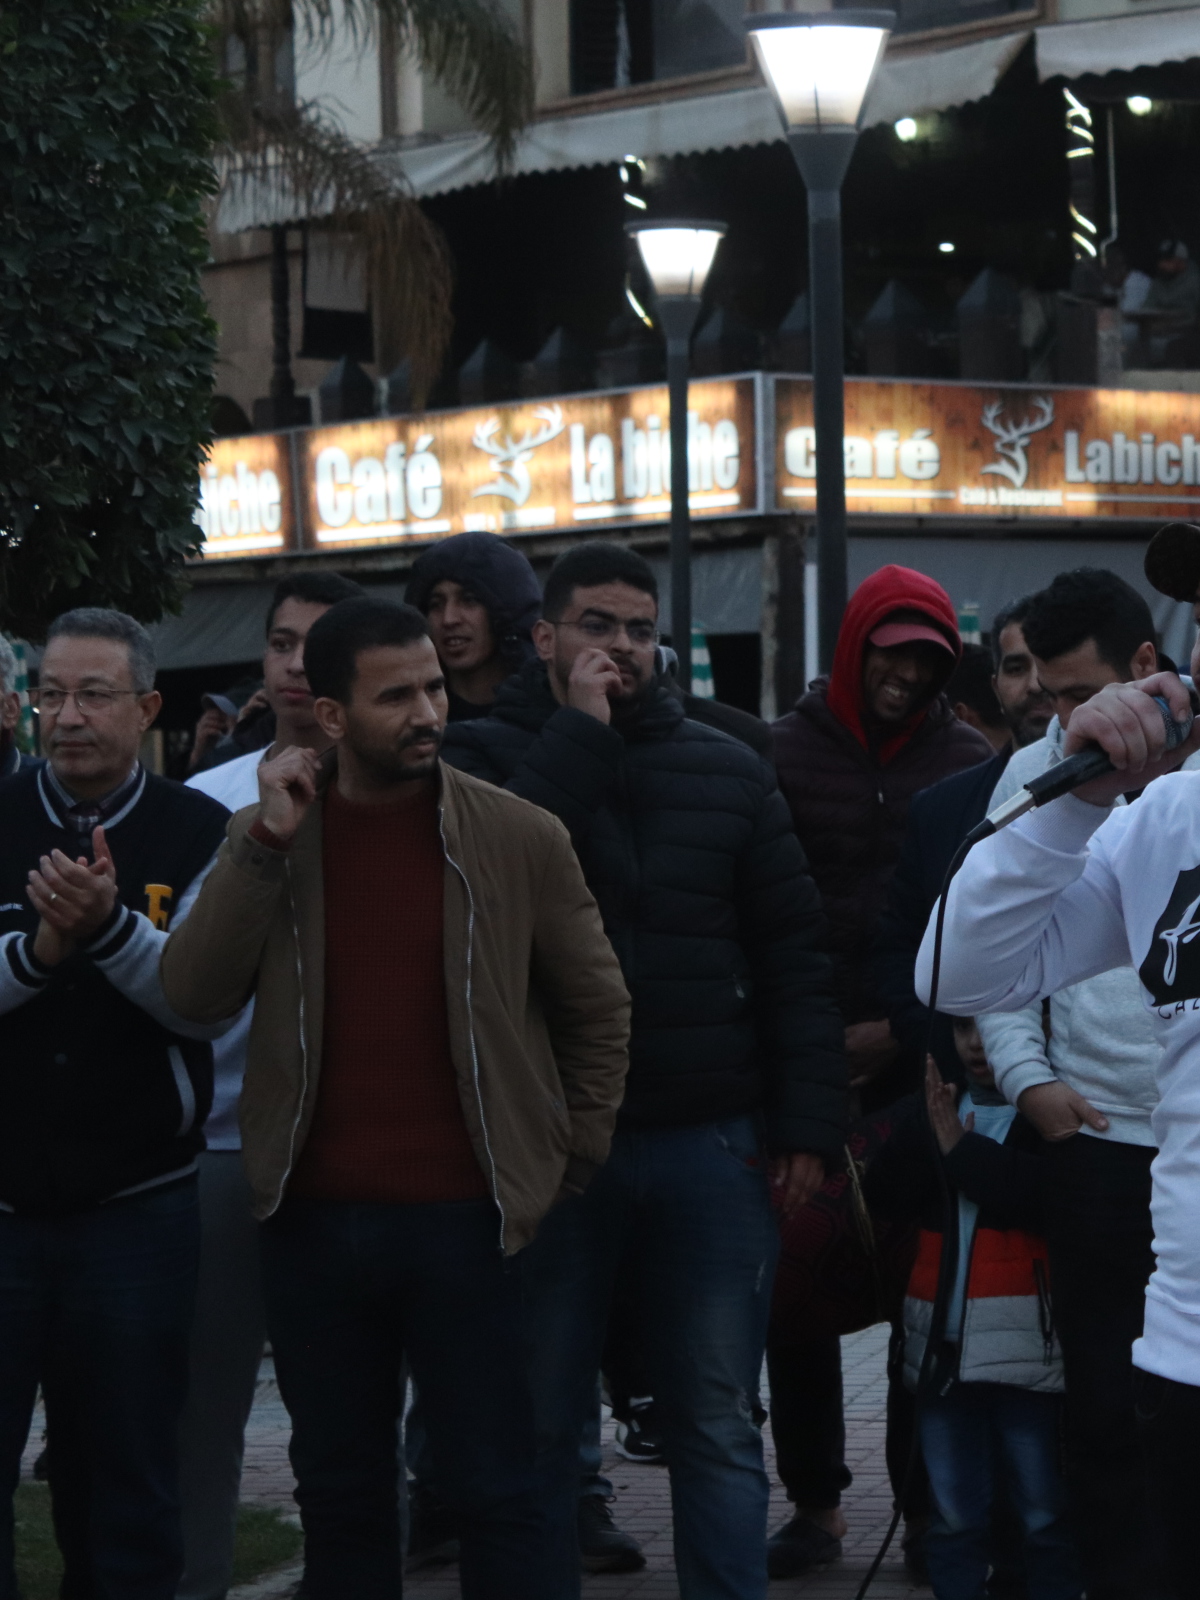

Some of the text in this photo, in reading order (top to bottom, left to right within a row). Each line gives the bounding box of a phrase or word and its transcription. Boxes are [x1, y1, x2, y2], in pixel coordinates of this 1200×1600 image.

[316, 410, 740, 528] Café La bihe
